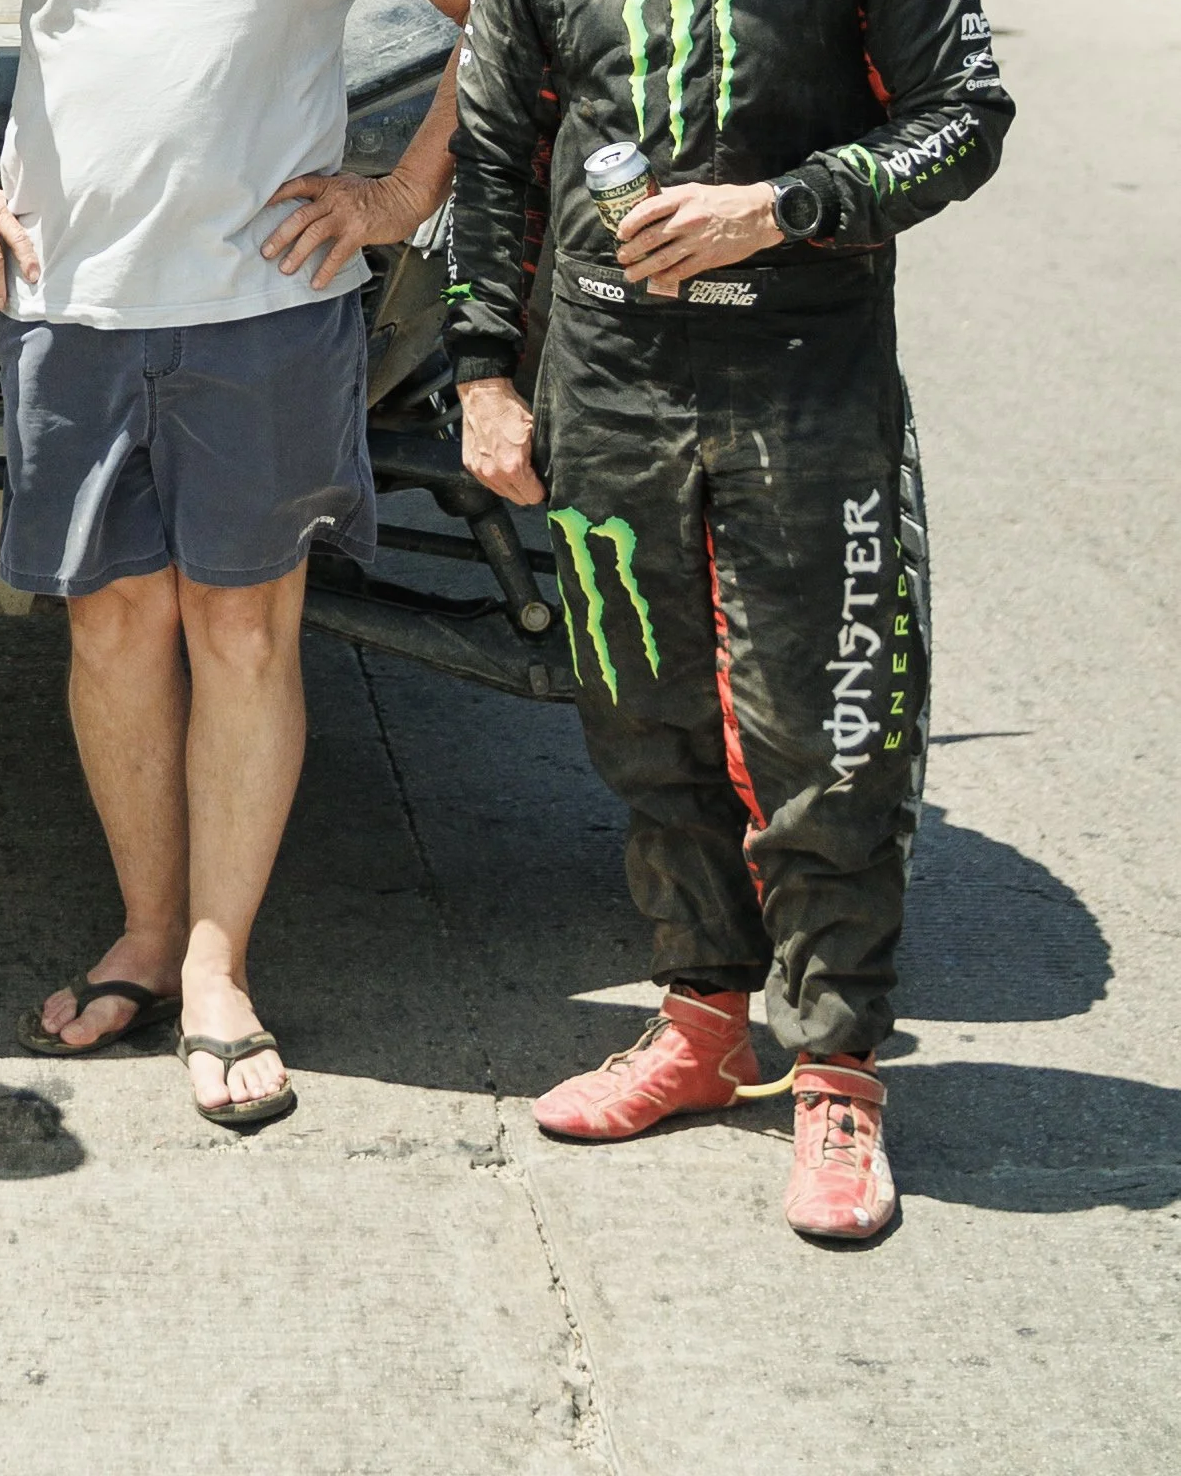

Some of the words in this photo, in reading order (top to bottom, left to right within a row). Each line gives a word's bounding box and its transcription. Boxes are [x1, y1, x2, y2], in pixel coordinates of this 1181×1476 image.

[881, 112, 980, 179] MONSTER
[900, 137, 977, 192] ENERGY
[578, 276, 625, 300] sparco
[688, 280, 752, 294] CASEY
[688, 293, 758, 306] CURRIE
[821, 488, 881, 794] MONSTER
[883, 536, 910, 751] ENERGY
